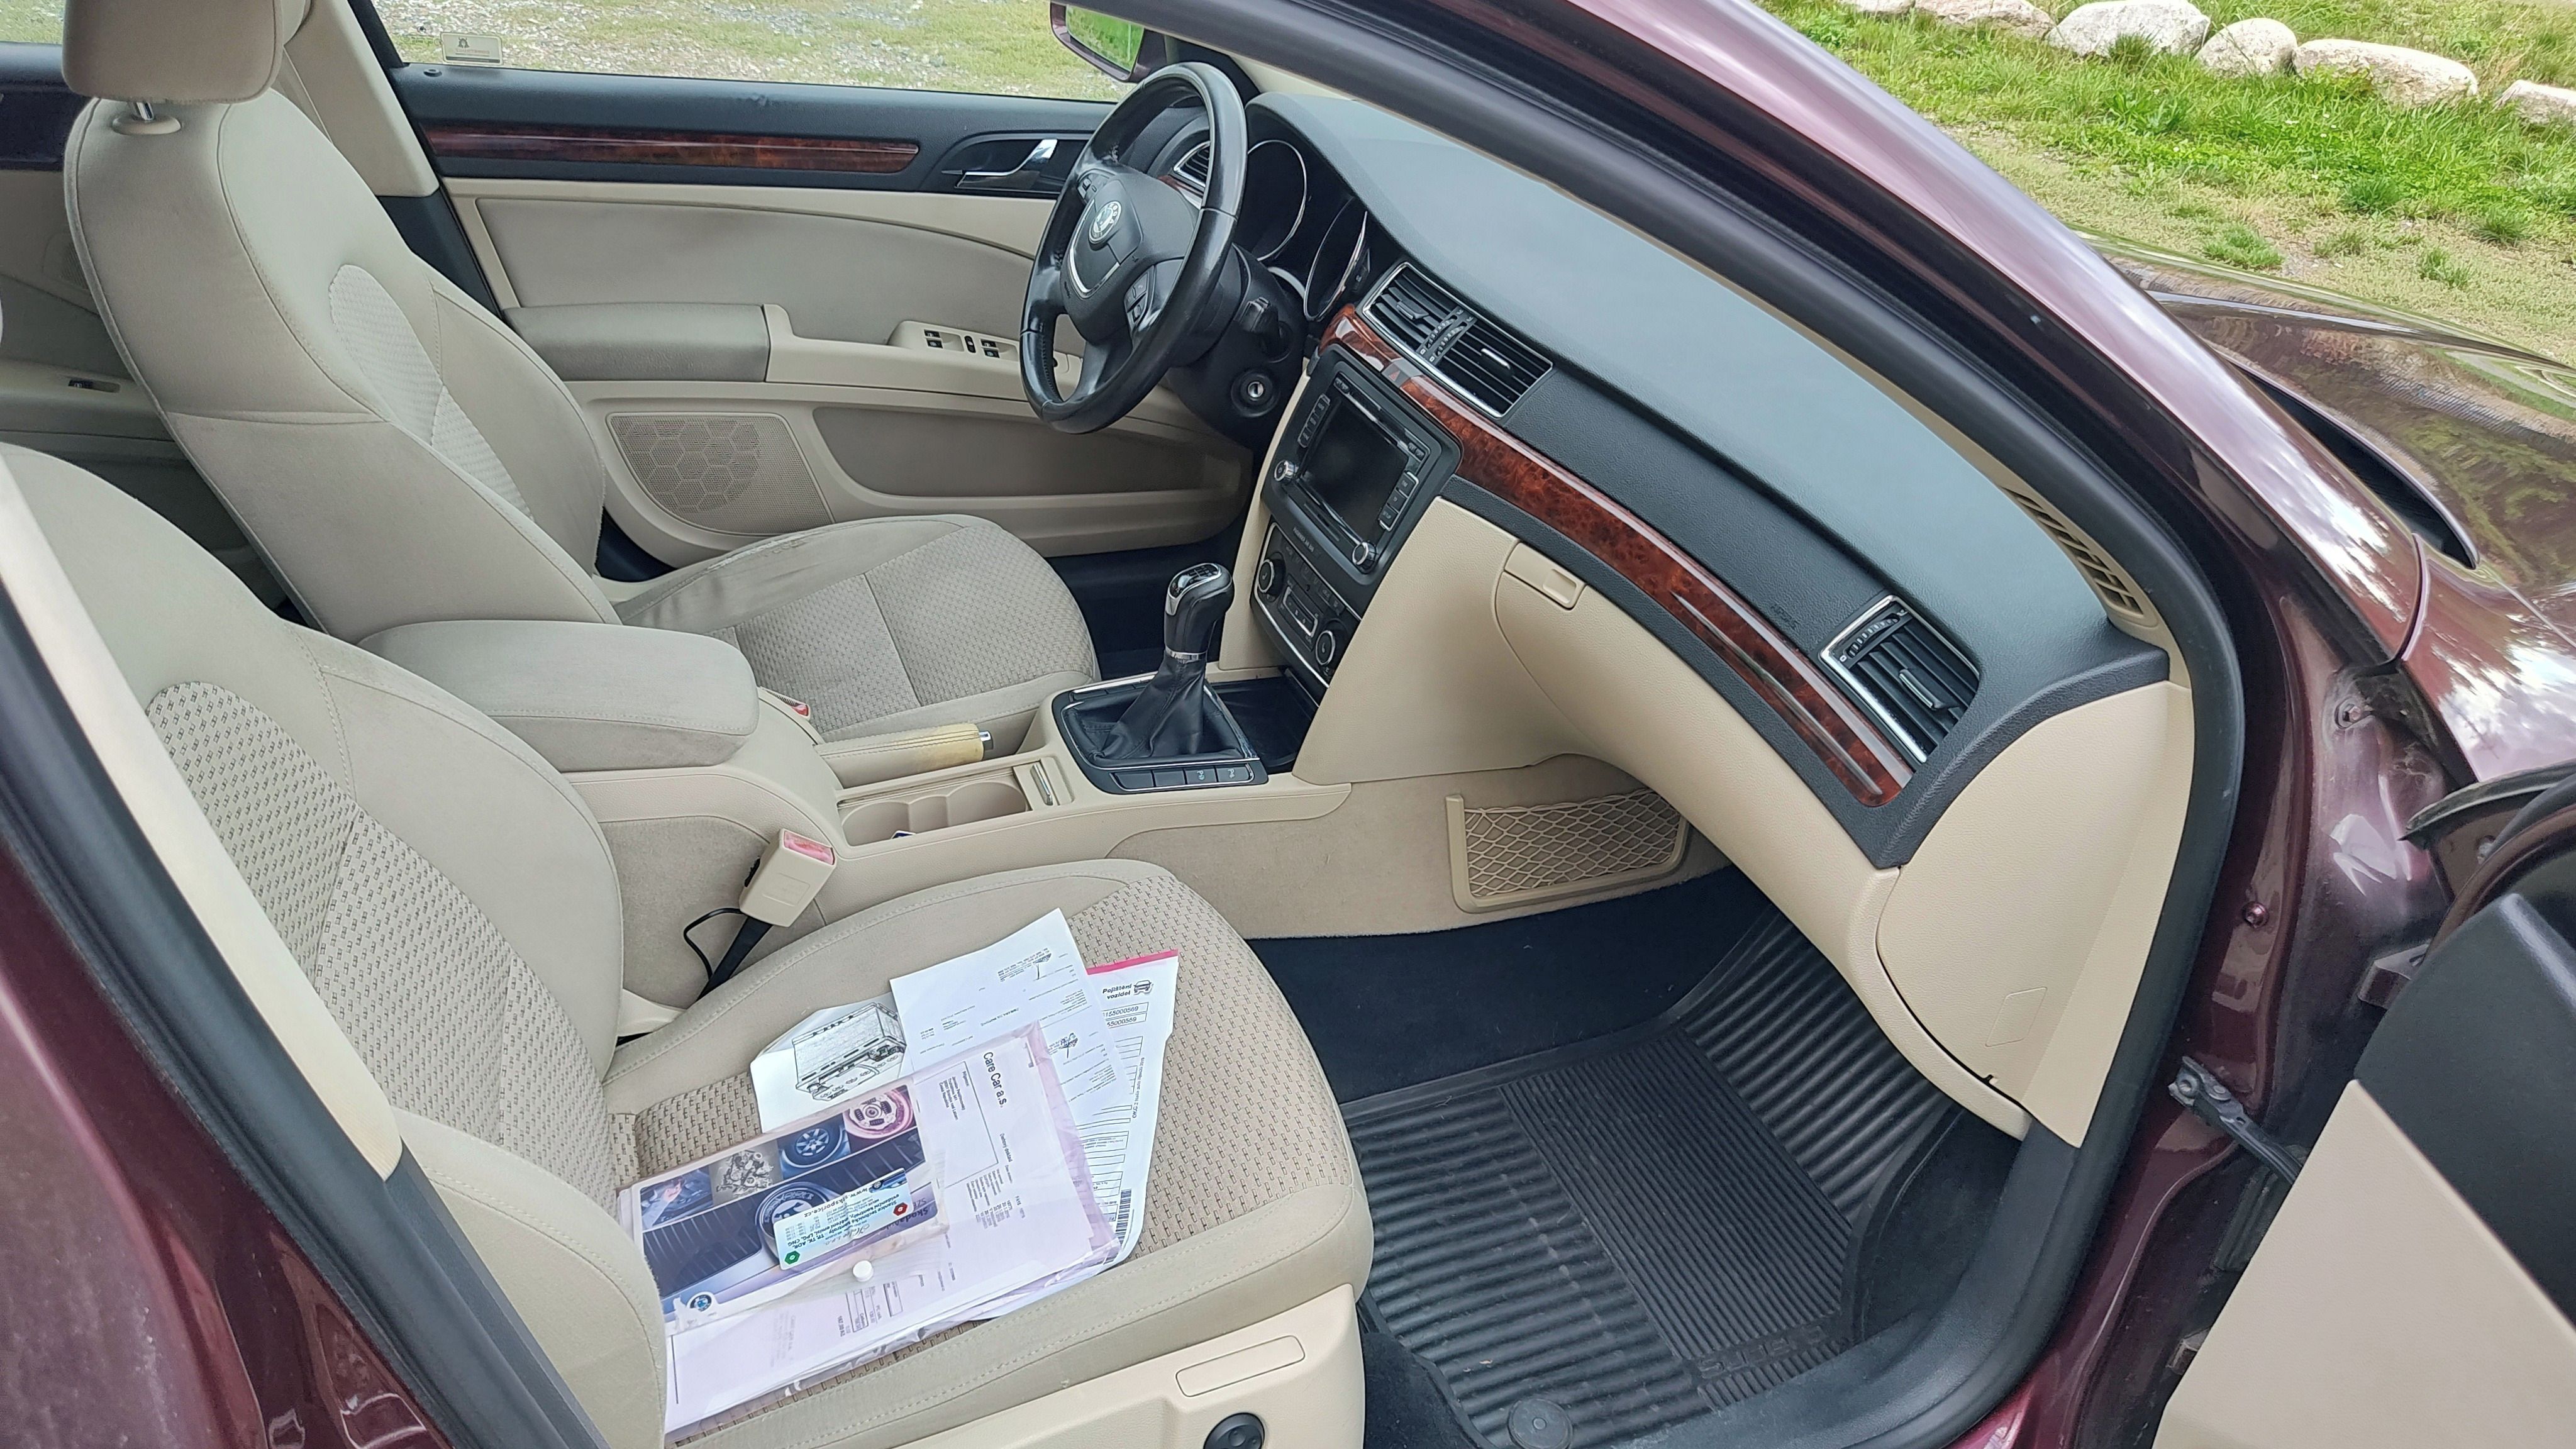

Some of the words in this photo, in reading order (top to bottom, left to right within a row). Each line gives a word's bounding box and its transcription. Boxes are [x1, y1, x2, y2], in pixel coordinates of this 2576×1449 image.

[983, 1052, 996, 1072] Care
[991, 1072, 1002, 1089] Car
[996, 1090, 1007, 1108] a.s.
[804, 1187, 868, 1218] www.stksporice.cz
[877, 1200, 897, 1212] Stanice
[851, 1210, 877, 1224] technické
[787, 1238, 800, 1246] CNG
